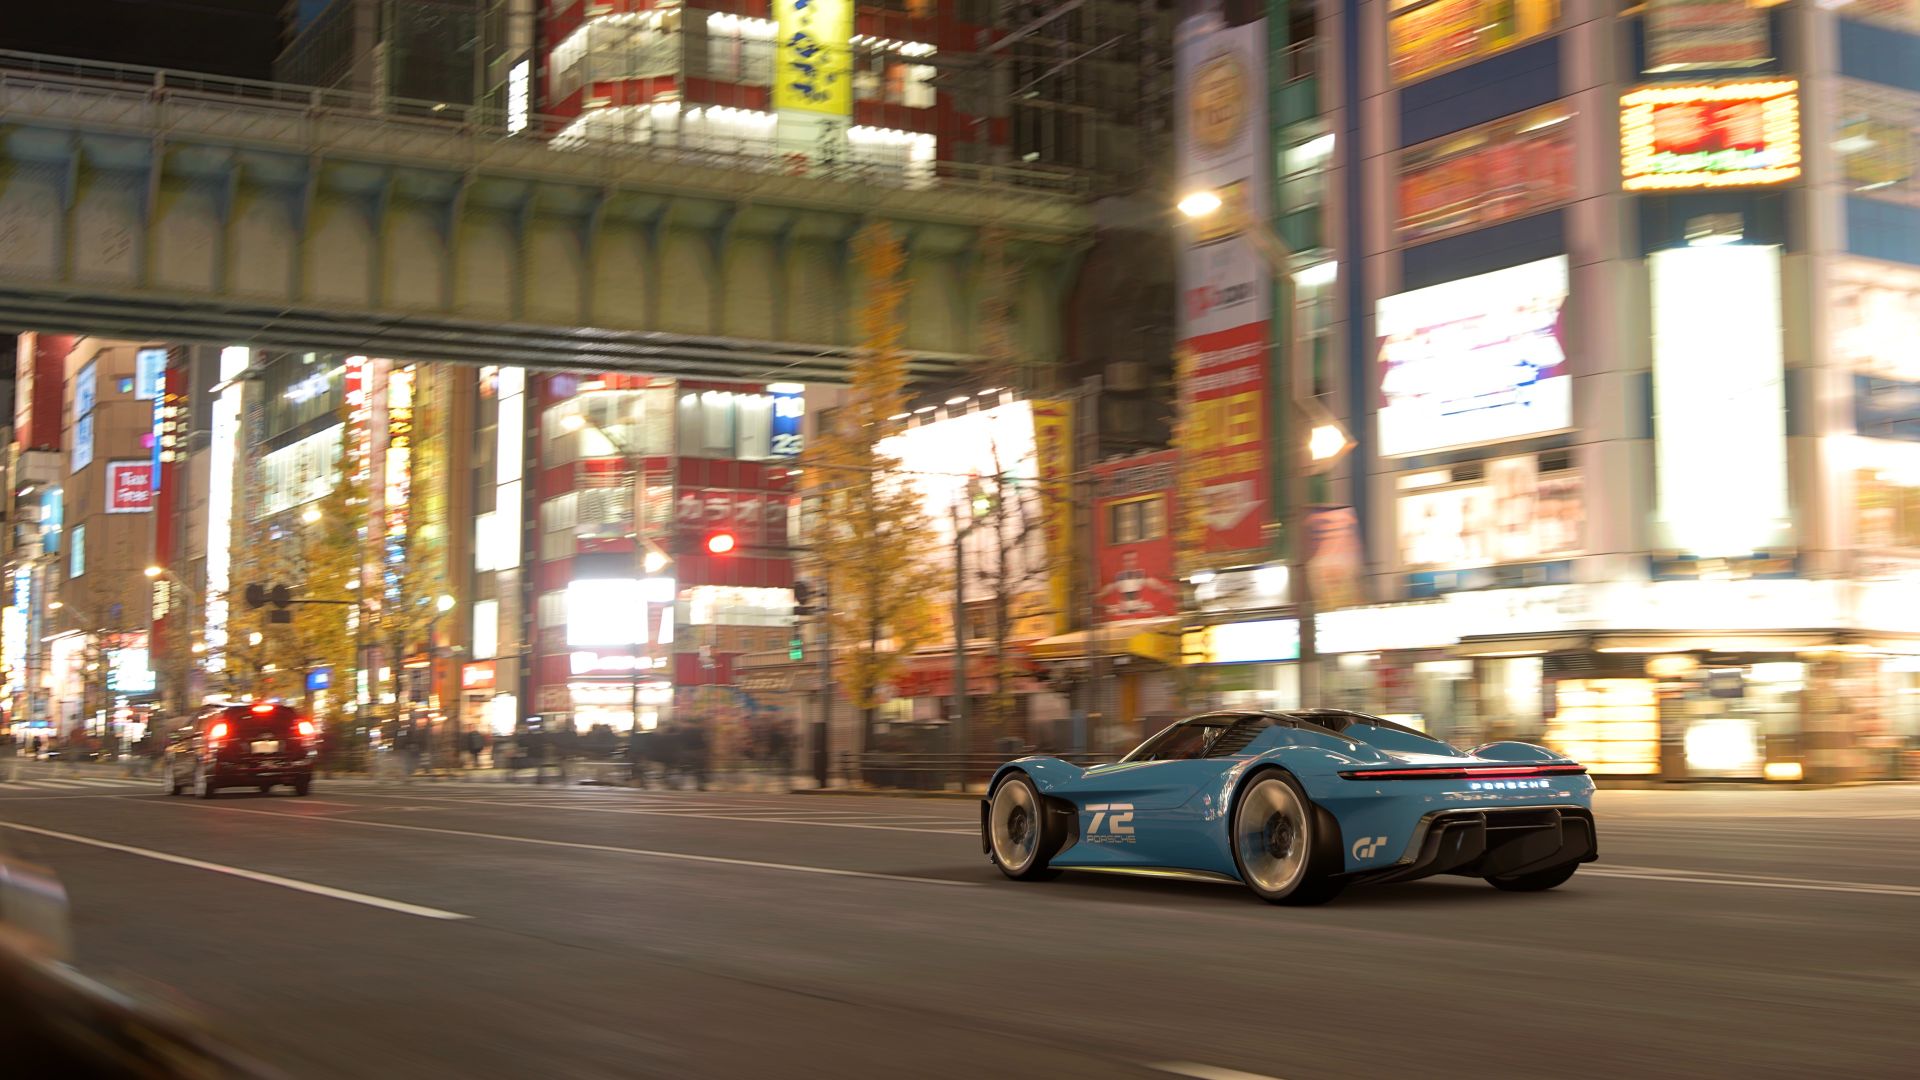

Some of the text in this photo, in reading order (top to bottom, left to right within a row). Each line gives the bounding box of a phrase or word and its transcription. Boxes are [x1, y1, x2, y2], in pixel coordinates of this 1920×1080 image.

[119, 471, 148, 486] Tax
[117, 487, 149, 502] Free
[1470, 780, 1550, 790] PORSCHE
[1085, 803, 1135, 834] 72
[1087, 835, 1137, 843] PORSCHE
